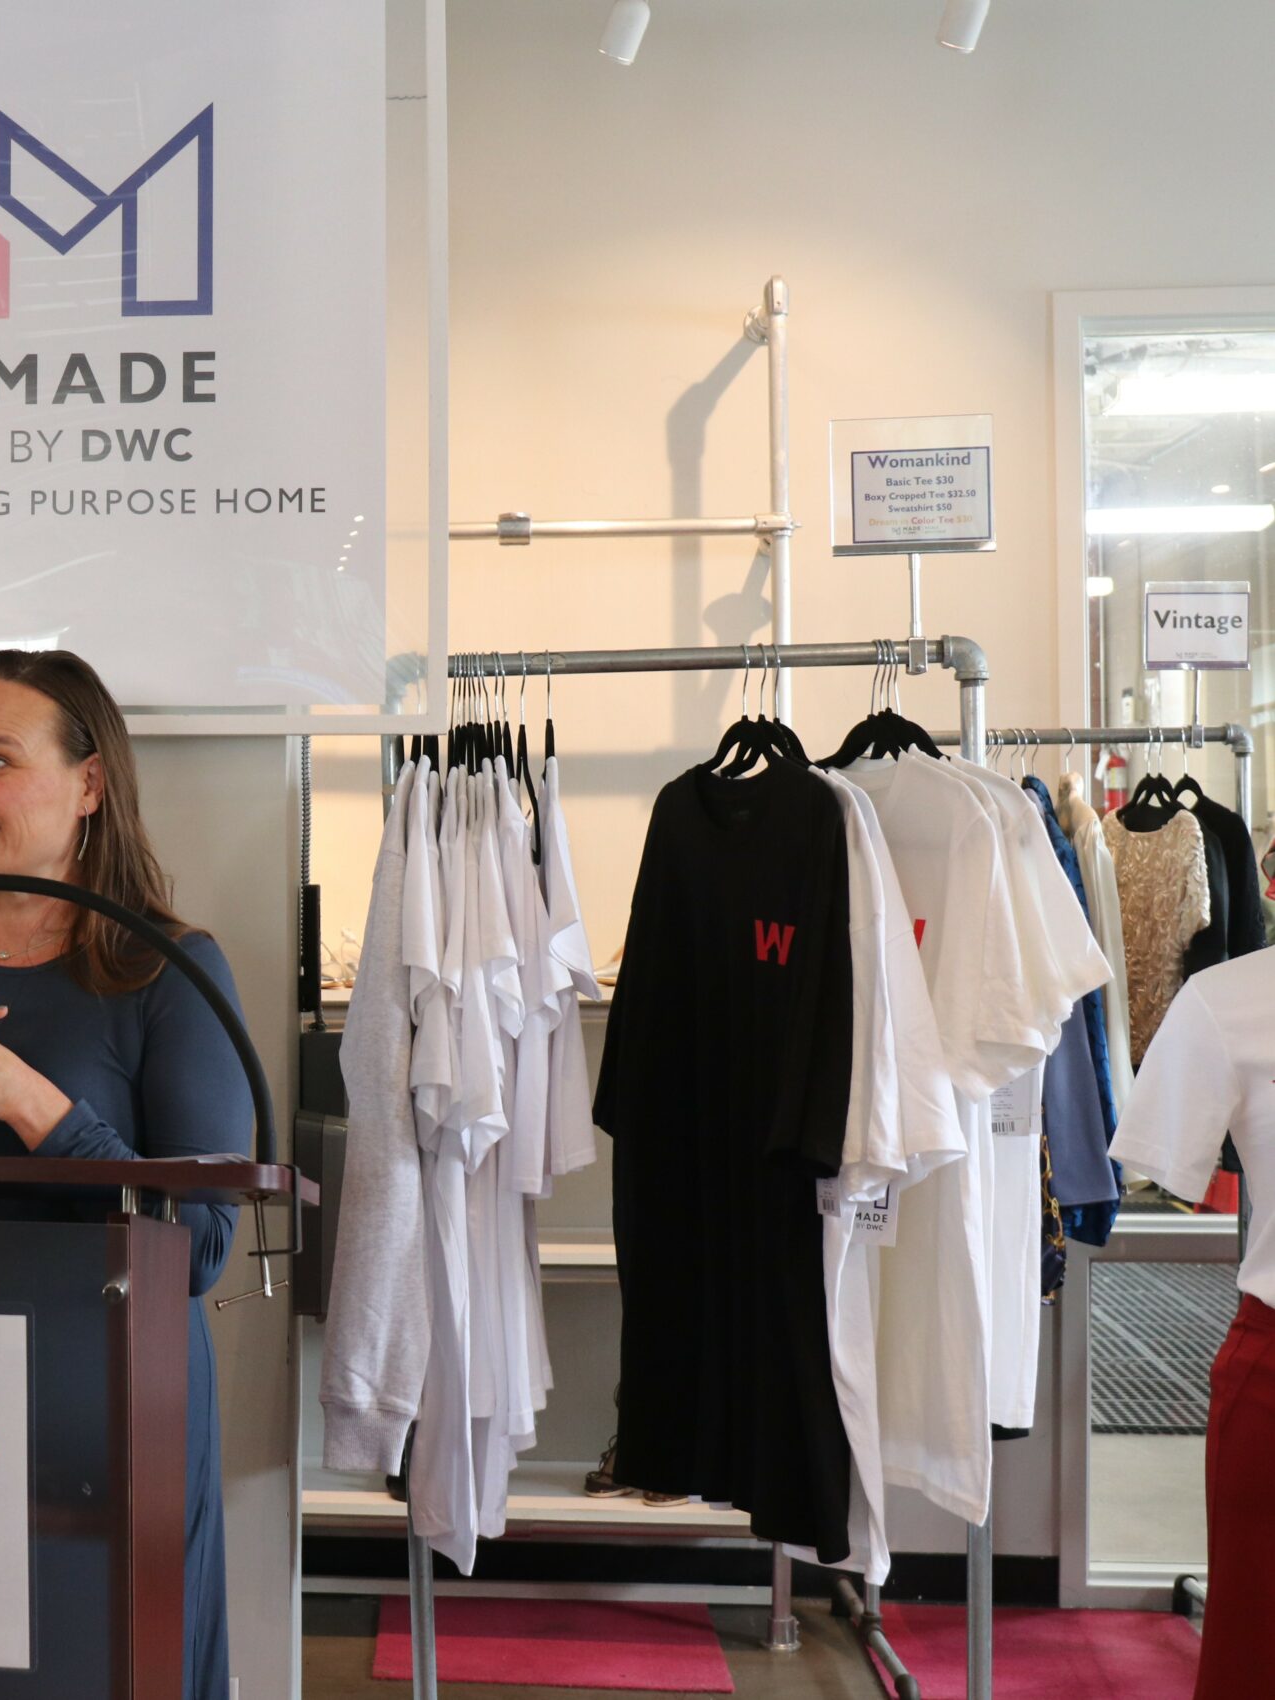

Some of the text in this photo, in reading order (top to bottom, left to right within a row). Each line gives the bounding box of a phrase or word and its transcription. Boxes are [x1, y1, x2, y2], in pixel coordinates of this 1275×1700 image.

[9, 426, 193, 464] BY DWC
[867, 452, 971, 469] Womankind
[885, 475, 954, 486] Basic Tee $30
[29, 487, 197, 516] PURPOSE
[215, 486, 327, 514] HOME
[864, 489, 976, 502] Boxy Cropped Tee $32.50
[888, 503, 952, 513] Sweatshirt $50
[911, 516, 937, 525] Color
[1153, 610, 1243, 635] Vintage
[855, 1212, 888, 1223] MADE
[866, 1223, 883, 1231] DWC
